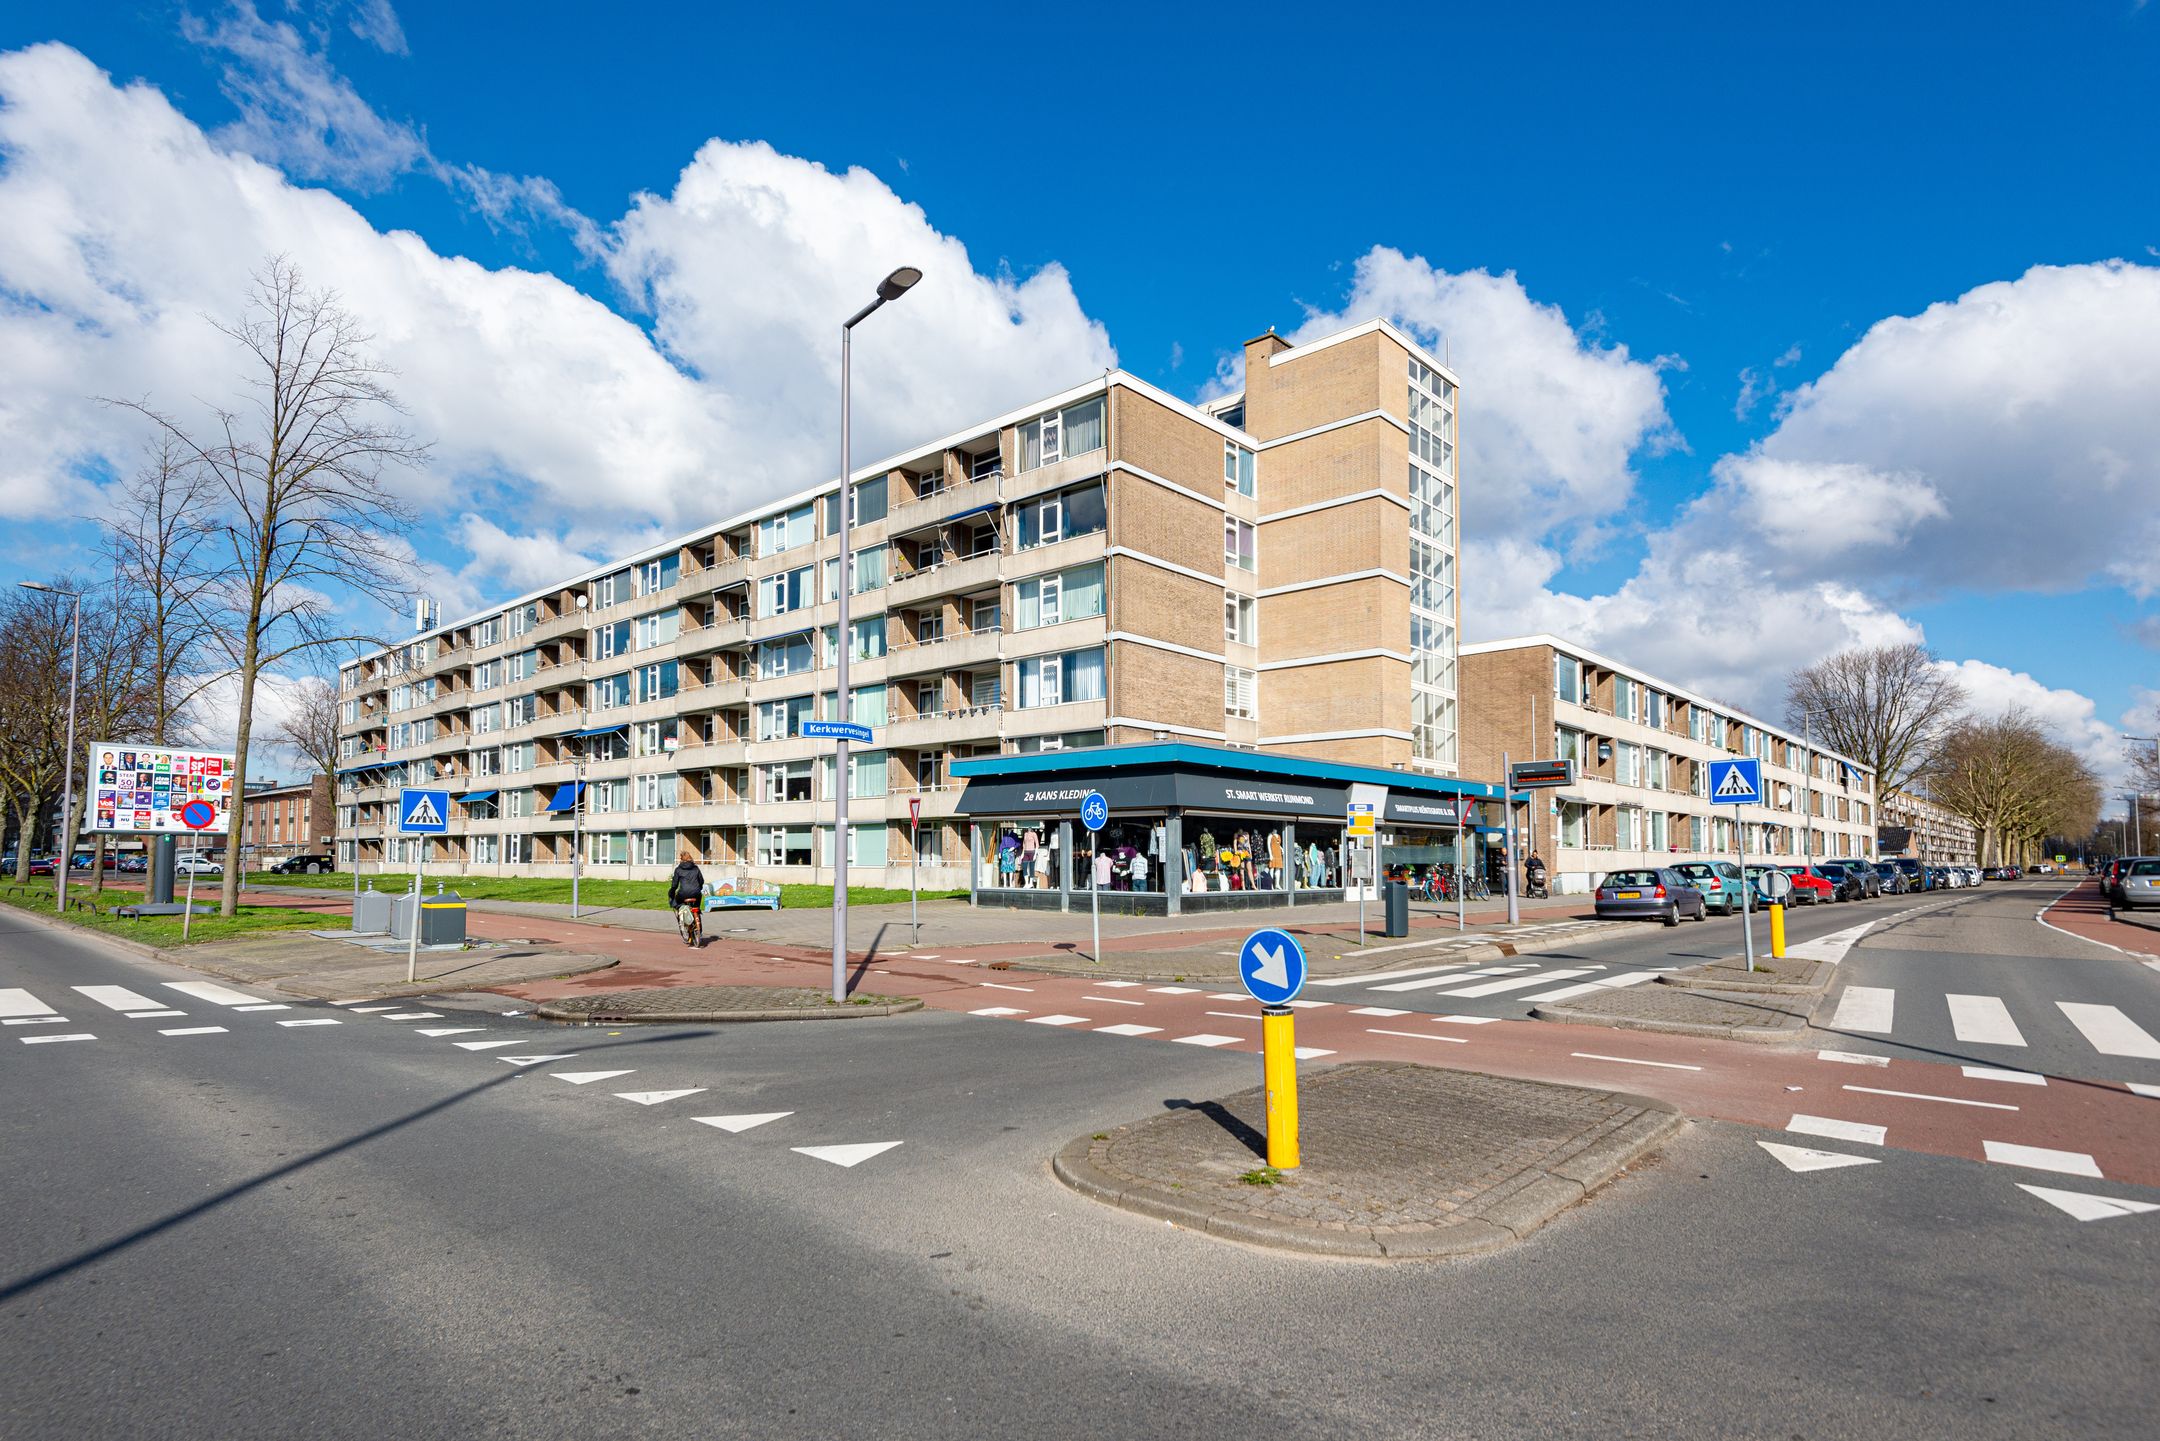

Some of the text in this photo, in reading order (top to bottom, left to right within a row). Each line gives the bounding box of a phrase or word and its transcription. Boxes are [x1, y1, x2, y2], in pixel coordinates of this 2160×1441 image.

[809, 724, 870, 738] Kerkwervesingel
[190, 761, 205, 771] SP
[1023, 792, 1034, 802] 2e
[1035, 790, 1058, 801] KANS
[1225, 789, 1236, 799] ST.
[1235, 790, 1258, 801] SMART
